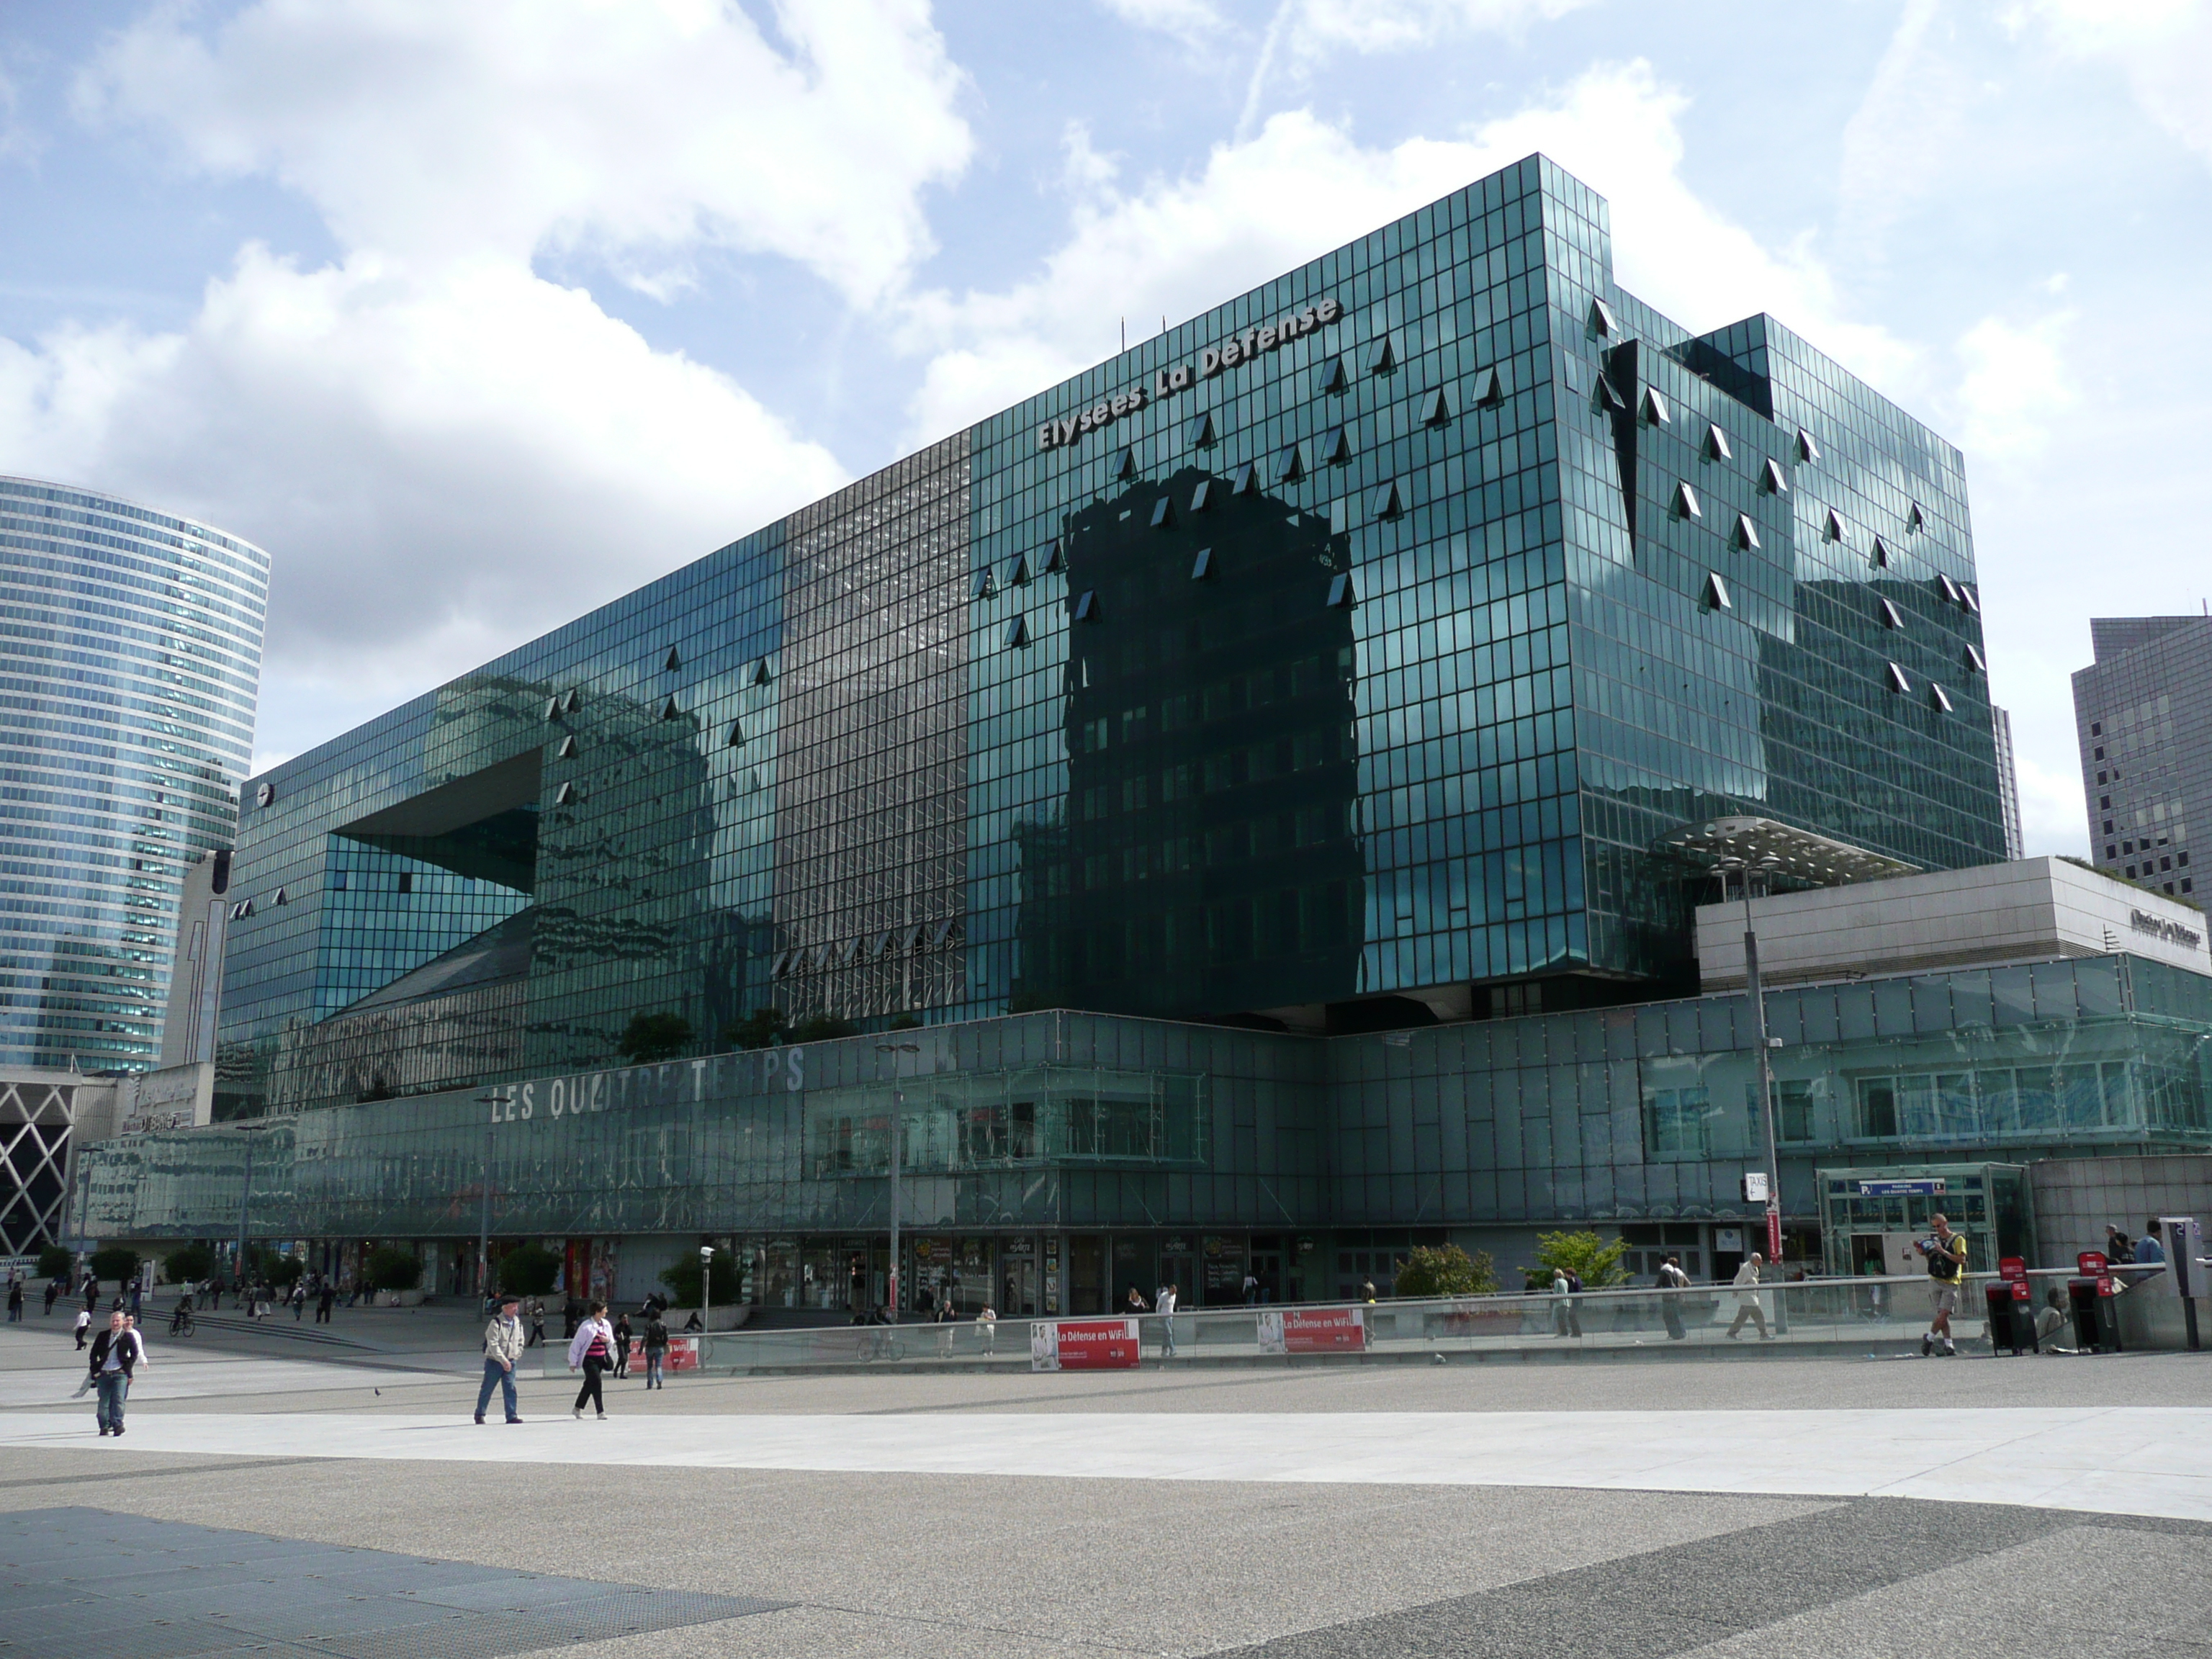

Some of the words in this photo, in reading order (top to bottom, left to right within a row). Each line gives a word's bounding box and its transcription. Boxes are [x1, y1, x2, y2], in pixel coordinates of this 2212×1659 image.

[1156, 364, 1190, 397] La
[1200, 297, 1342, 378] Défense
[491, 1082, 534, 1123] LES
[691, 1046, 804, 1102] TEPS
[1748, 1176, 1767, 1187] TAXIS
[1283, 1321, 1292, 1329] La
[1293, 1318, 1322, 1329] Défense
[1333, 1317, 1349, 1327] WiFi
[1058, 1332, 1066, 1341] La
[1067, 1330, 1097, 1341] Défense
[1097, 1332, 1107, 1341] en
[1108, 1329, 1125, 1340] WiFi
